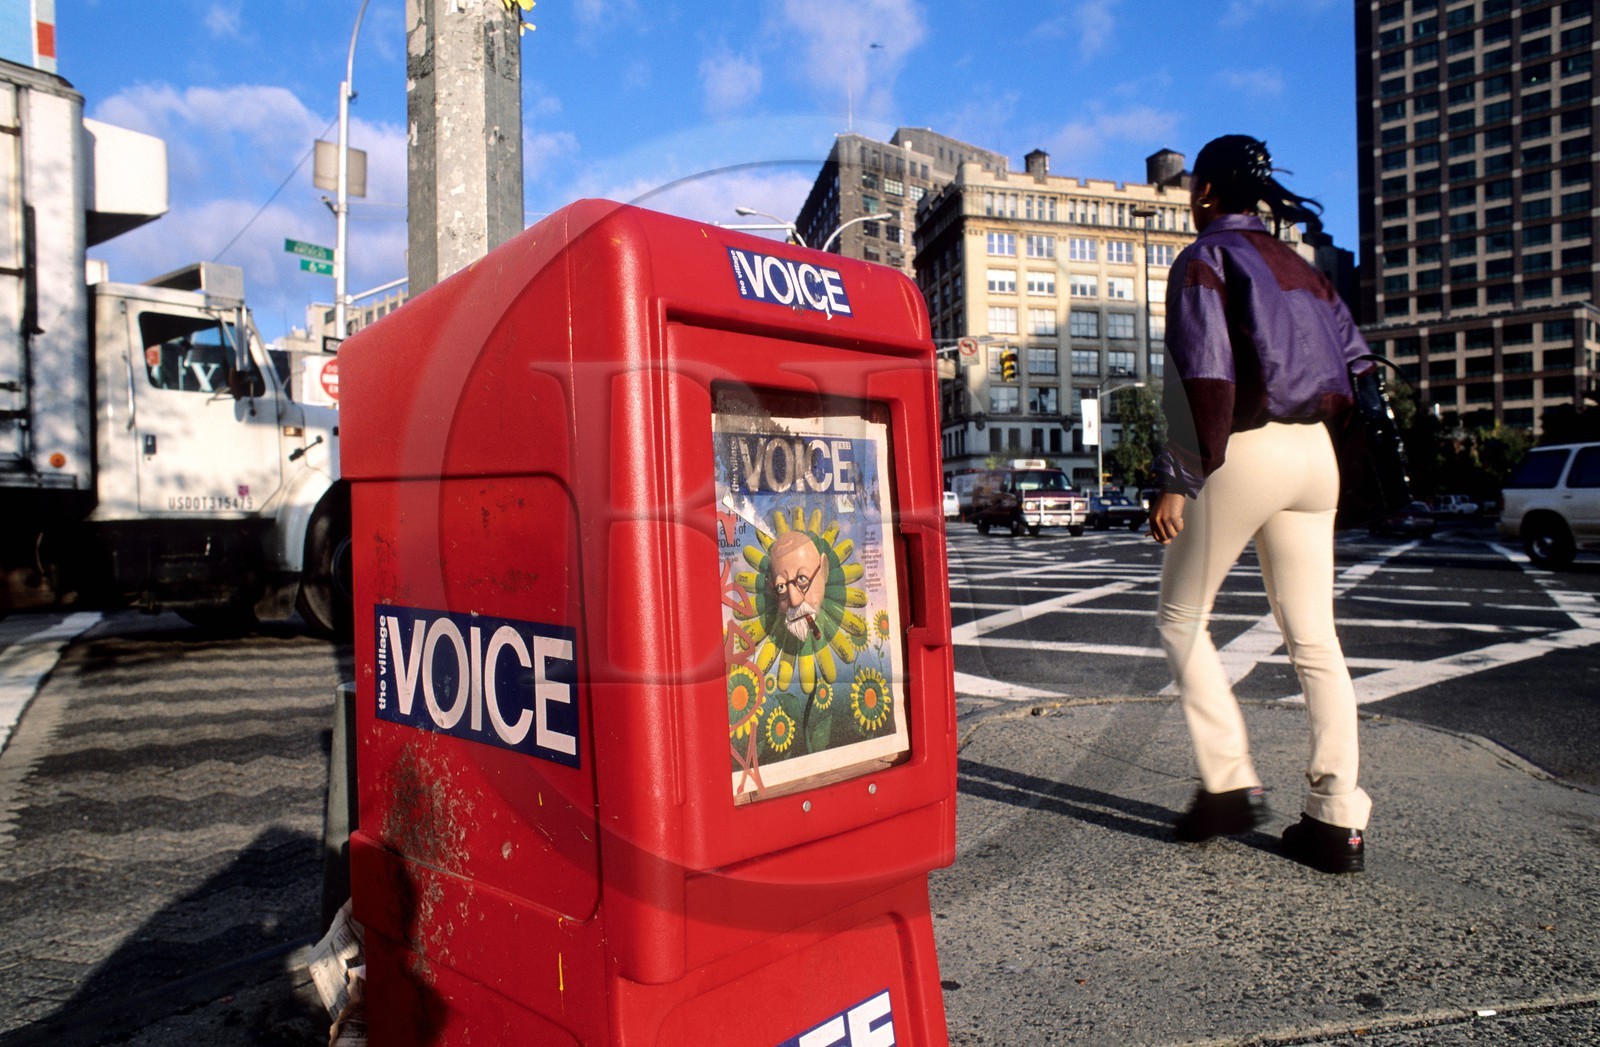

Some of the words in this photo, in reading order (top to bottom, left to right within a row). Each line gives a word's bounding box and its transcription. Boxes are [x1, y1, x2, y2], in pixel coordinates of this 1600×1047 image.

[730, 249, 743, 278] village
[735, 250, 851, 315] VOICE
[737, 436, 855, 493] VOICE
[378, 614, 388, 676] village
[378, 679, 388, 710] the
[386, 616, 577, 756] VOICE
